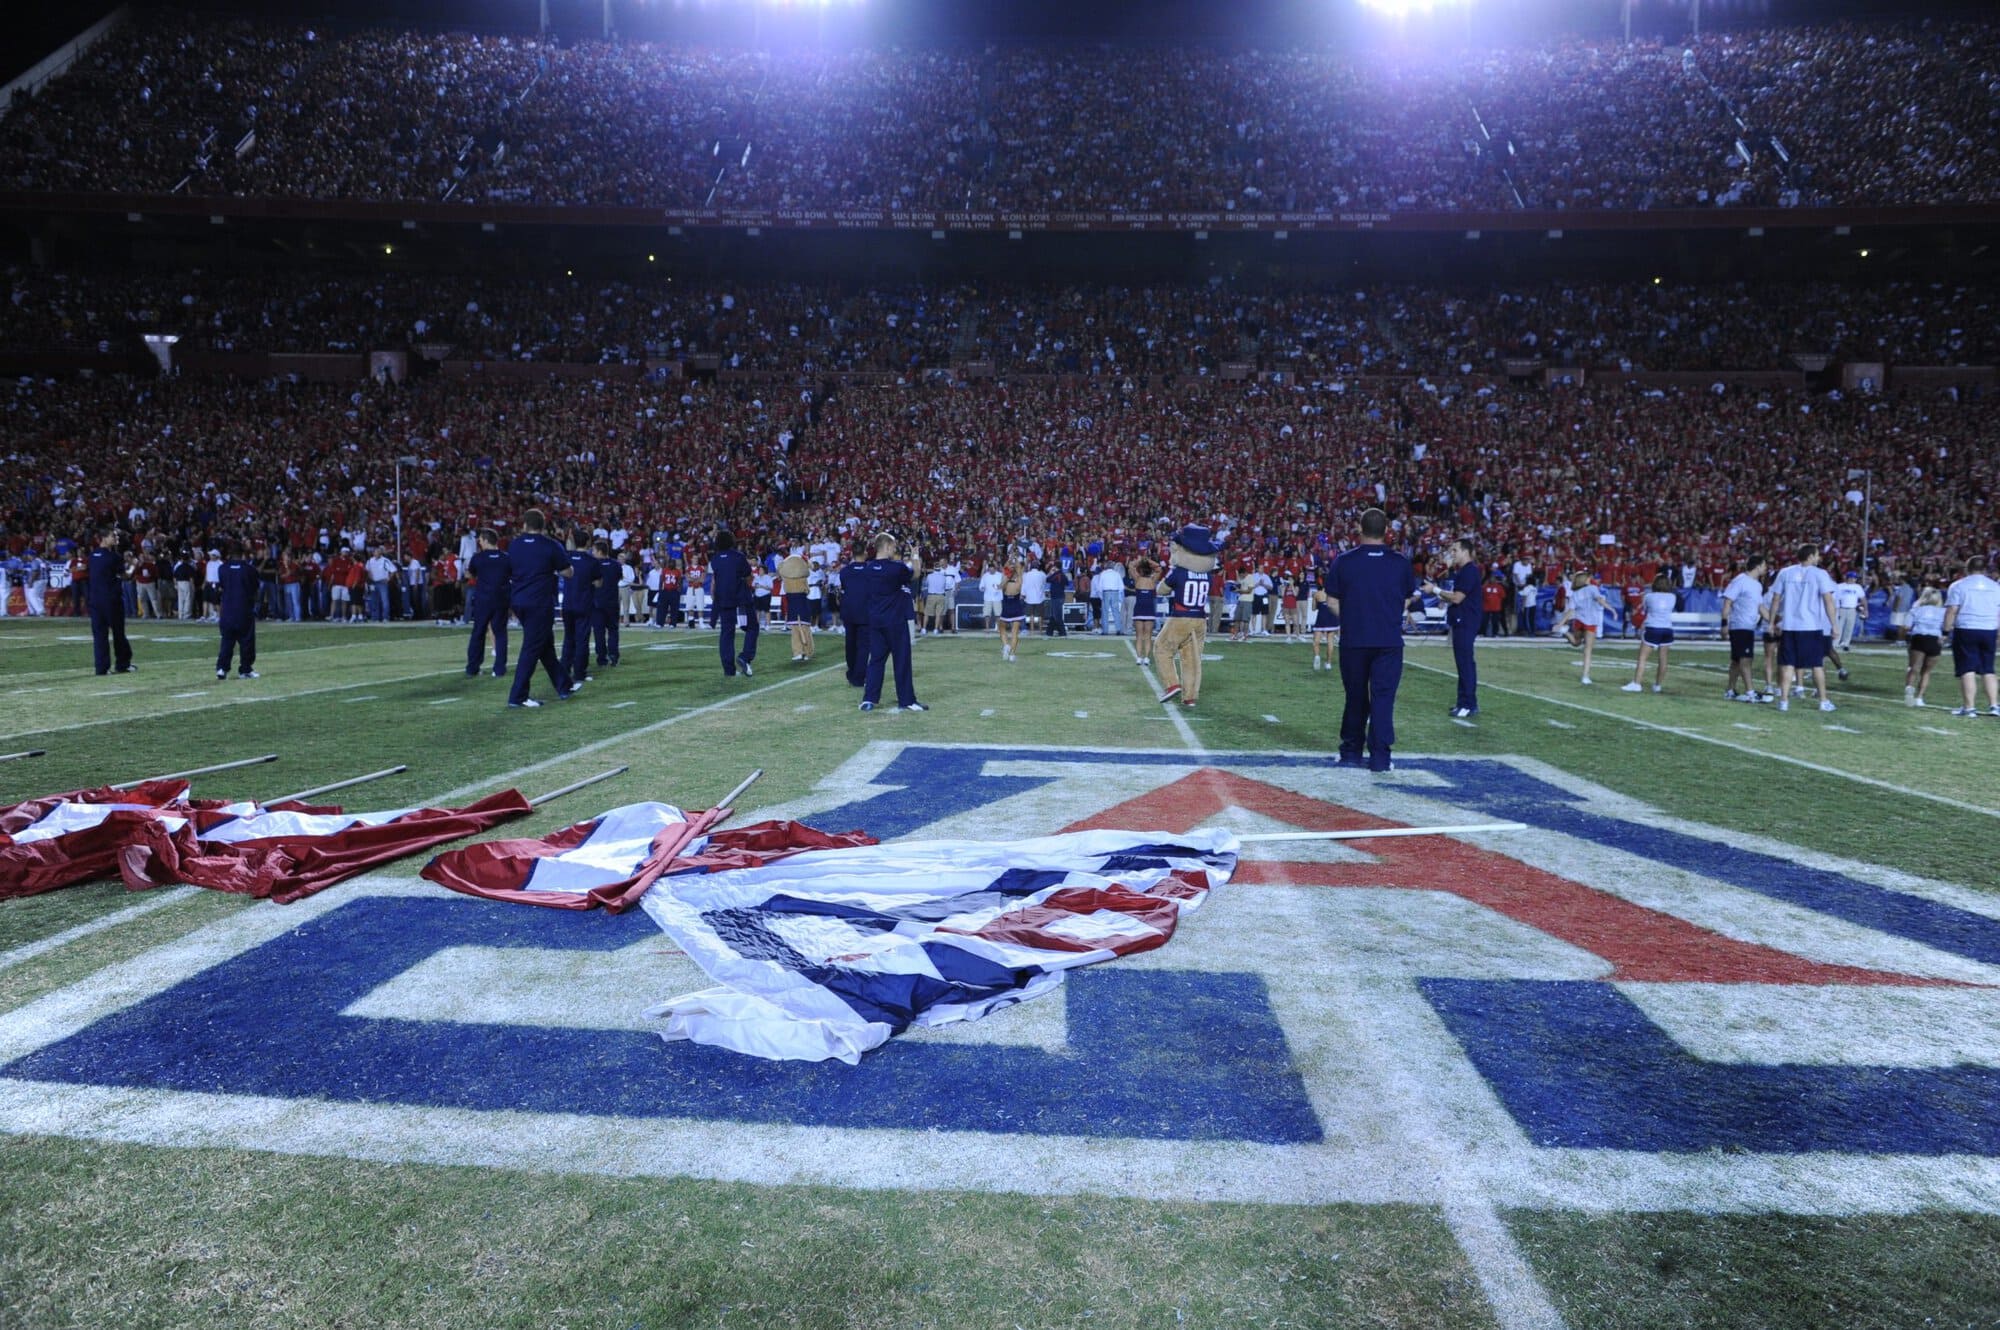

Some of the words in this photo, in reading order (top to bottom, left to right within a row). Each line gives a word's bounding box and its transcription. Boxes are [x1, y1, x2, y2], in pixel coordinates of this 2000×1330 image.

[804, 211, 828, 220] BOWL
[912, 212, 936, 221] BOWL
[944, 213, 970, 222] FIESTA
[971, 213, 995, 222] BOWL
[1183, 580, 1210, 607] 08
